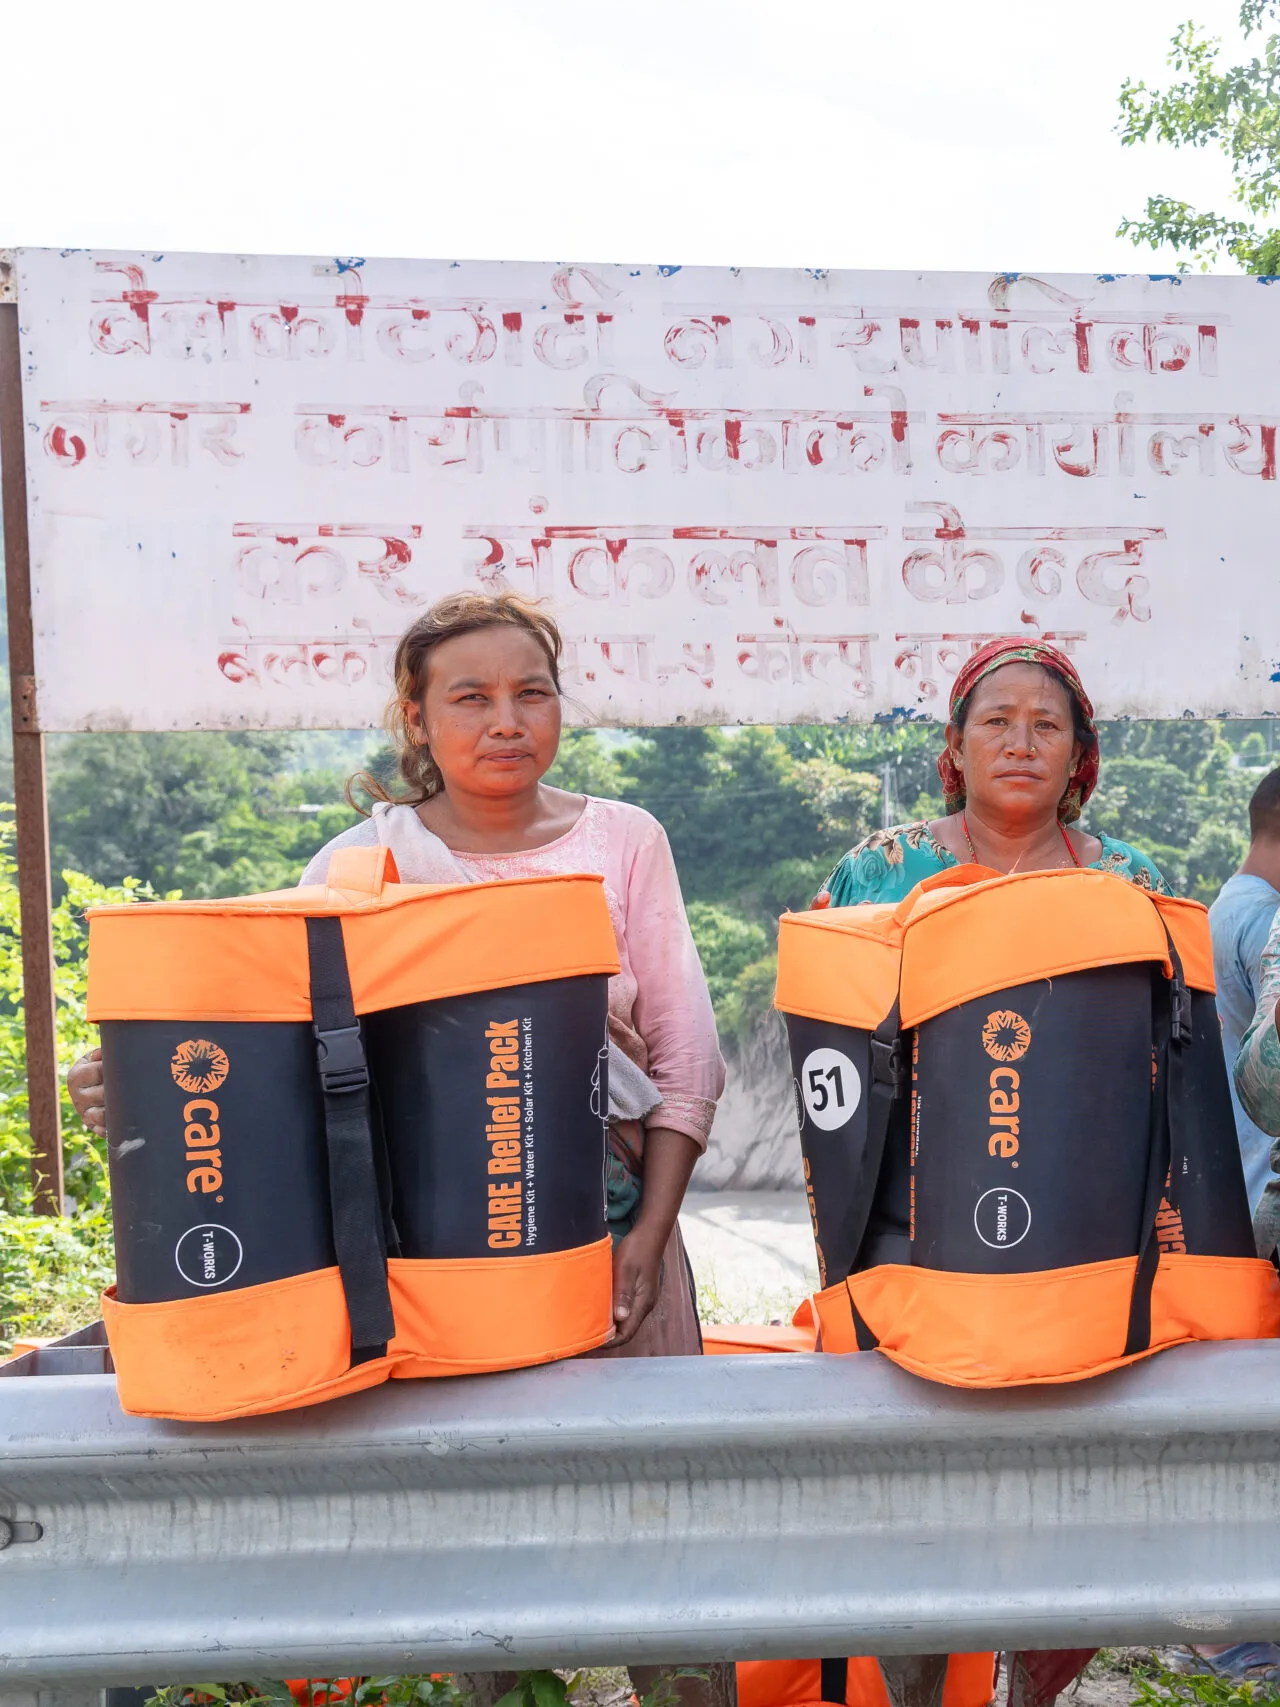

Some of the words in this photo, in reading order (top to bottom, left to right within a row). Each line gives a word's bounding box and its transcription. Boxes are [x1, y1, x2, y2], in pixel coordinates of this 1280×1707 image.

[662, 276, 1231, 379] नगरपालिका
[40, 398, 252, 468] नगर
[231, 521, 427, 604] कर
[521, 1017, 532, 1032] Kit
[485, 1020, 521, 1089] Pack
[522, 1033, 534, 1071] Kitchen
[523, 1081, 534, 1096] Kit
[523, 1097, 534, 1123] Solar
[807, 1066, 846, 1113] 51
[987, 1067, 1021, 1157] care
[183, 1098, 223, 1193] care
[486, 1096, 522, 1175] Relief
[524, 1133, 535, 1148] Kit
[525, 1149, 536, 1180] Water
[487, 1180, 522, 1249] CARE
[525, 1189, 536, 1204] Kit
[996, 1194, 1009, 1242] T-WORKS
[525, 1205, 539, 1246] Hygiene
[201, 1230, 216, 1280] T-WORKS
